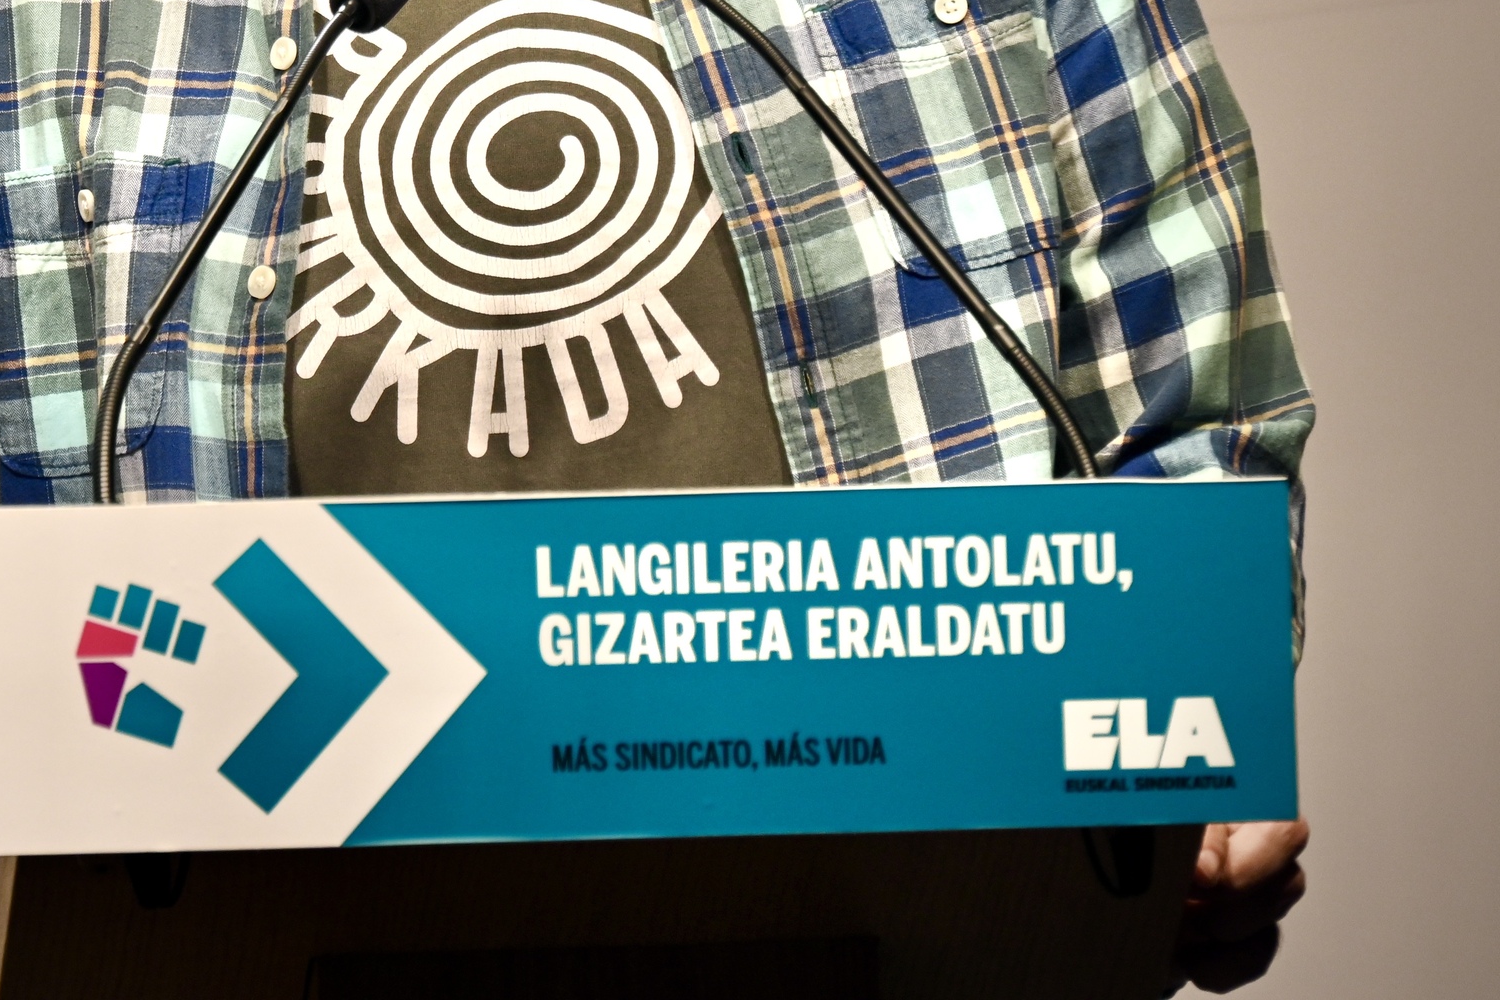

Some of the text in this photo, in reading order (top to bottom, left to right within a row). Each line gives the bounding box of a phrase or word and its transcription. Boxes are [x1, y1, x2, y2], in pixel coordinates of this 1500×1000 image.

[535, 531, 1133, 598] LANGILERIA ANTOLATU,
[538, 601, 1066, 667] GIZARTEA ERALDATU
[551, 732, 887, 773] MÁS SINDICATO, MÁS VIDA
[1062, 696, 1236, 771] ELA
[1065, 774, 1236, 793] EUSKAL SINDIKATUA
